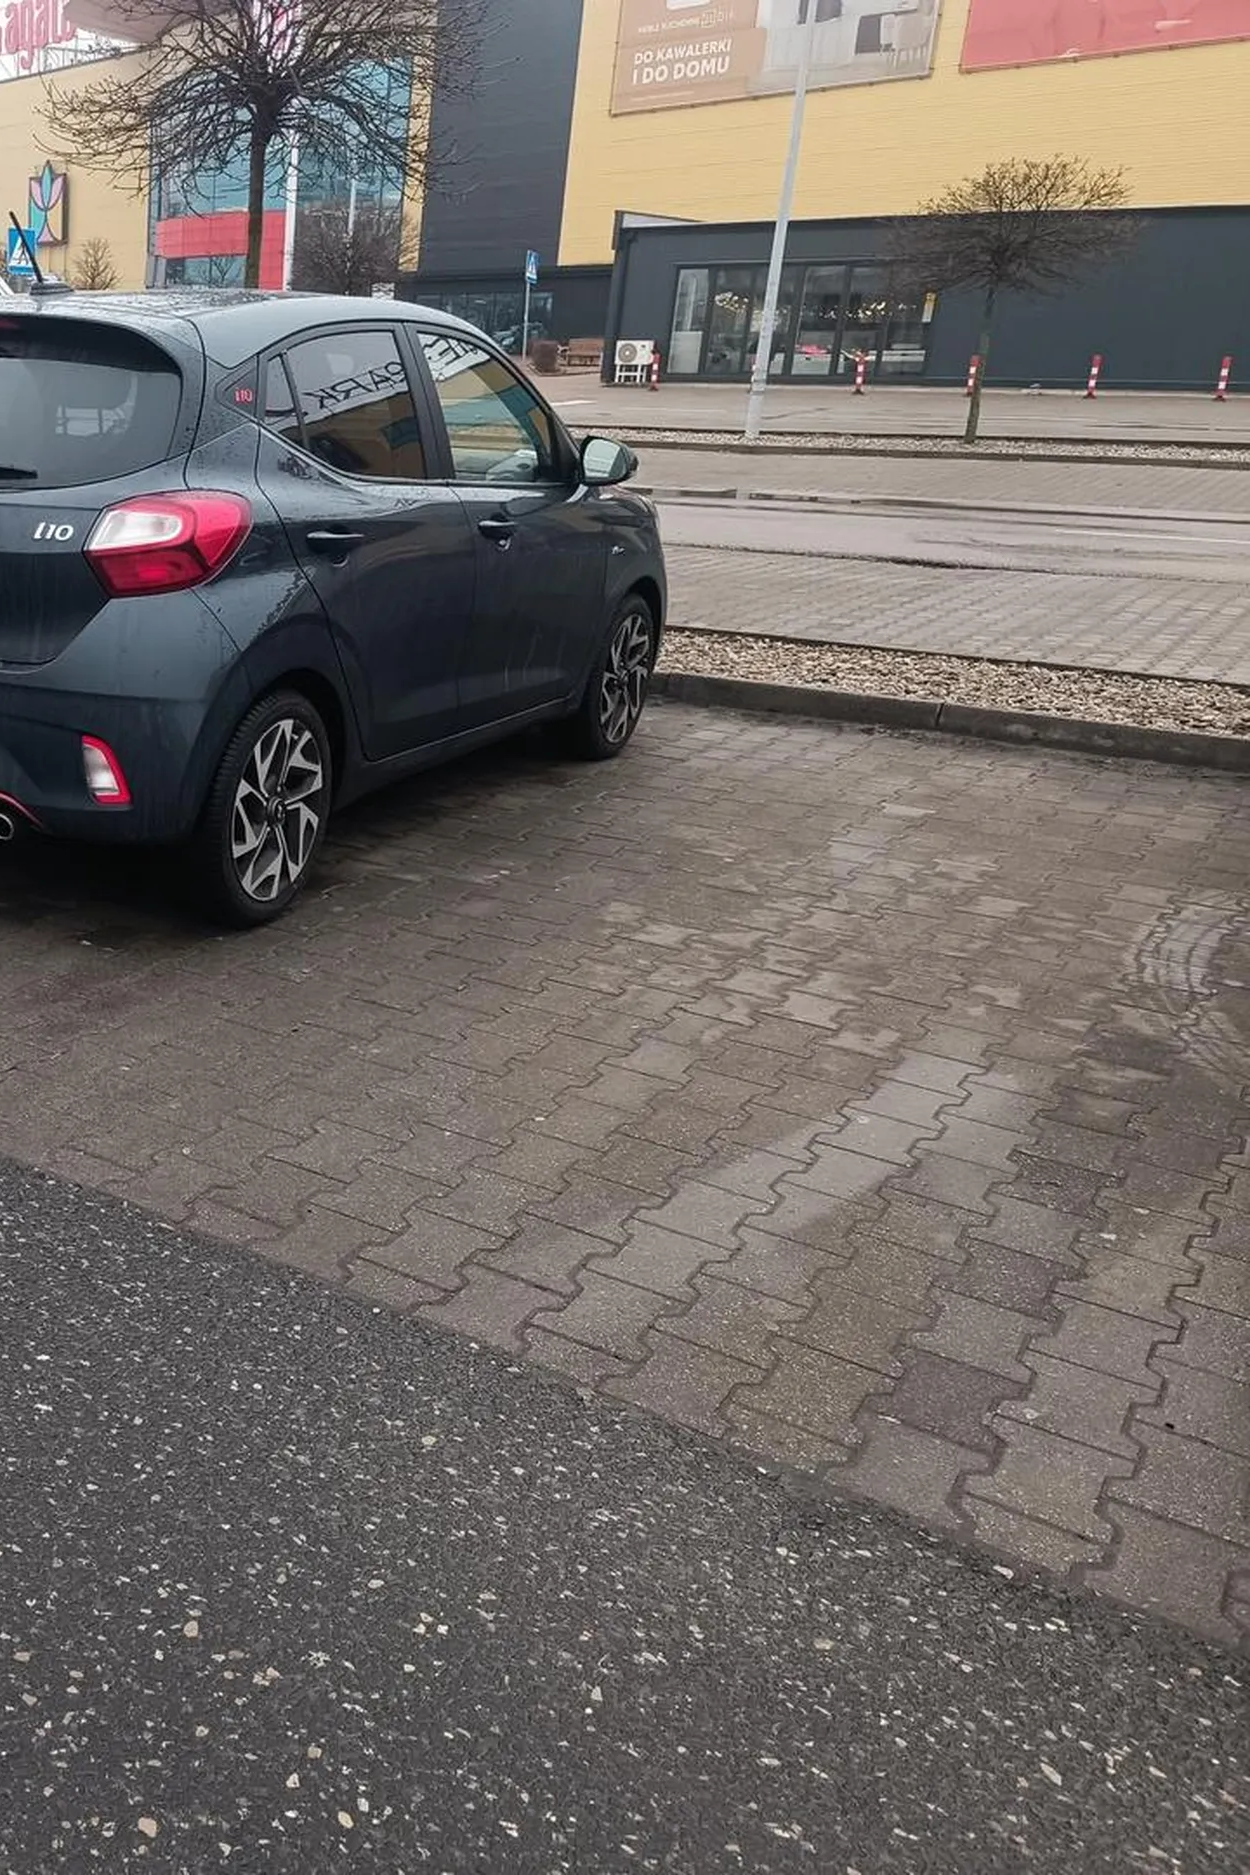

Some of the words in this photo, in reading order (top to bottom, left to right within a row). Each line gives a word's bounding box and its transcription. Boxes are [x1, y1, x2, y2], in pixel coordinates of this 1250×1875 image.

[634, 51, 654, 65] DO
[655, 39, 732, 61] KAWALERKI
[642, 65, 668, 84] DO
[673, 56, 730, 80] DOMU
